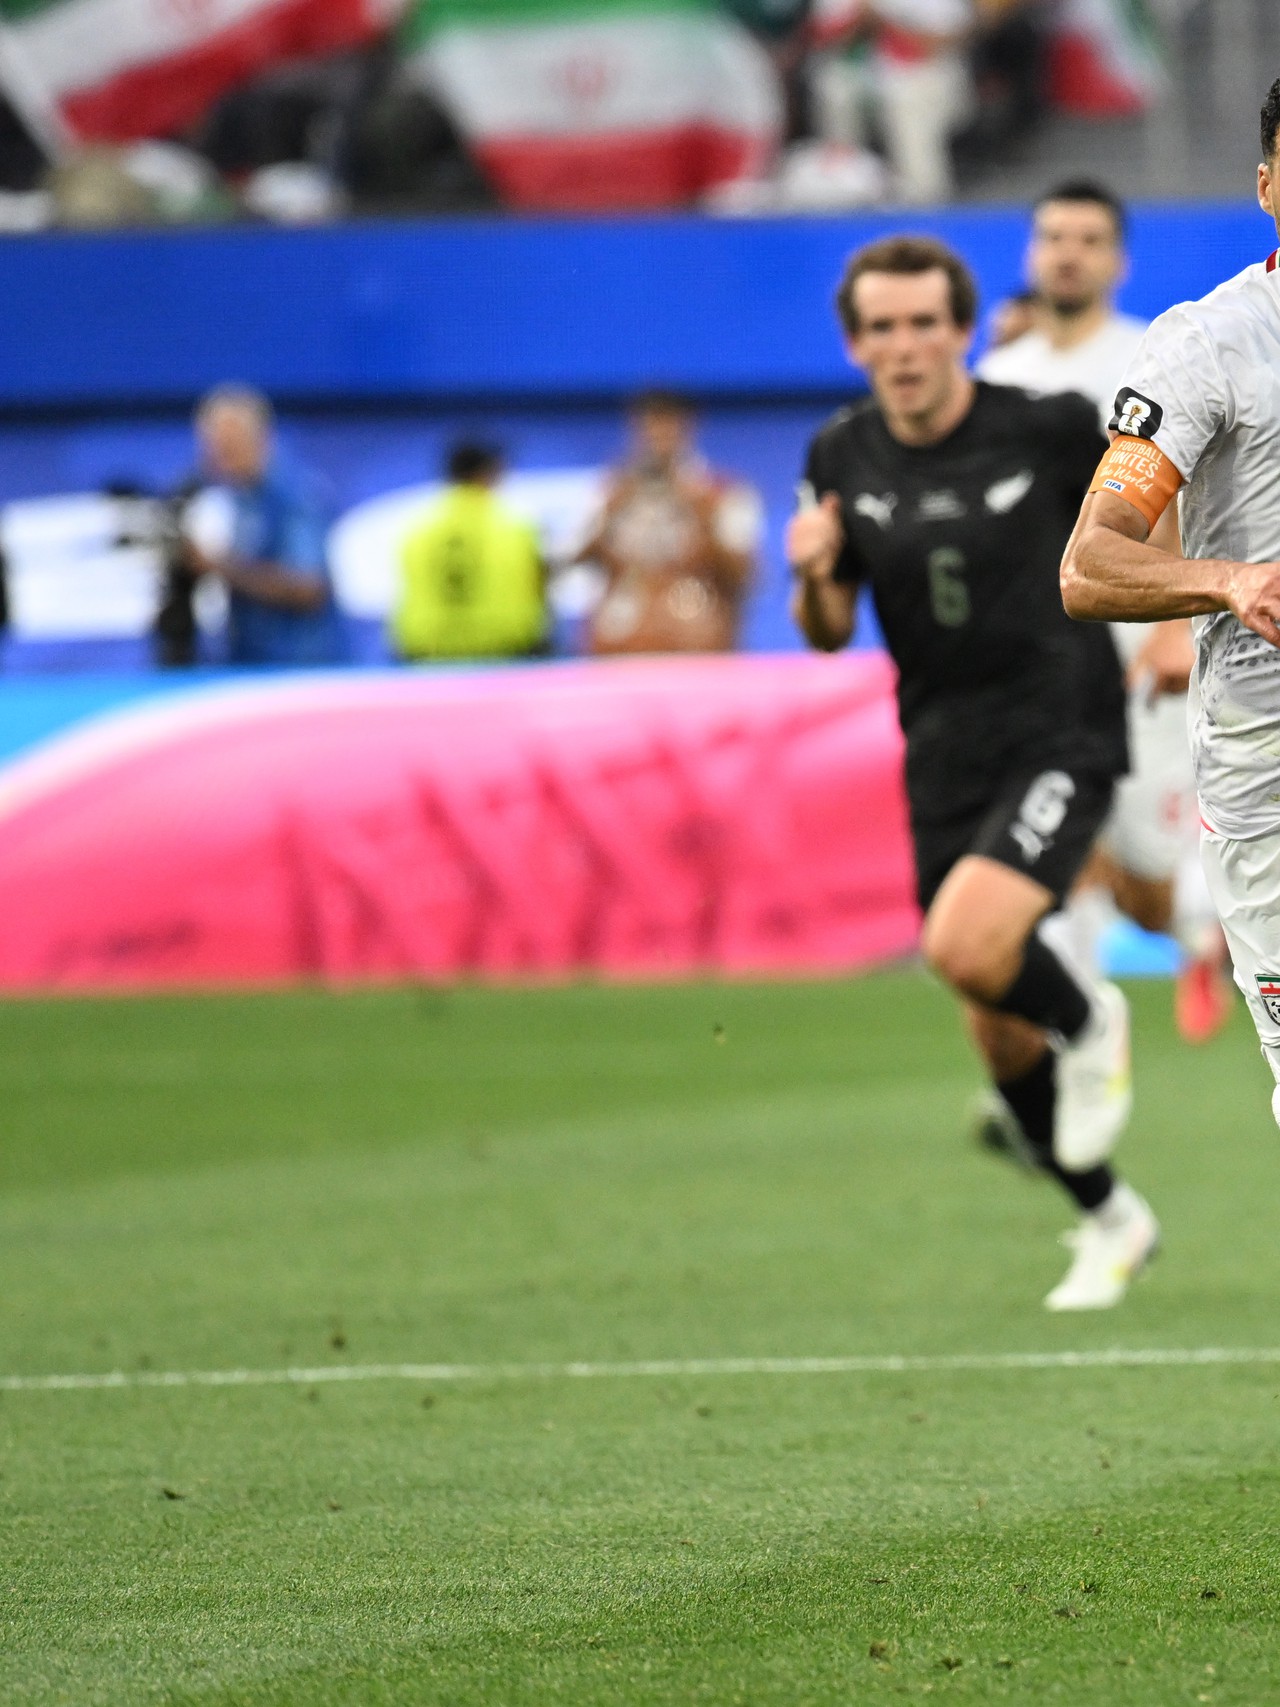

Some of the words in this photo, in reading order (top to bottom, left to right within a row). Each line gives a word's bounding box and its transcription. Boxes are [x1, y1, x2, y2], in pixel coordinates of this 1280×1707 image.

[1109, 451, 1159, 479] UNITES
[1117, 440, 1162, 465] FOOTBALL
[1104, 480, 1122, 491] FIFA
[1113, 467, 1154, 494] World
[929, 548, 970, 627] 6
[1019, 770, 1076, 837] 6
